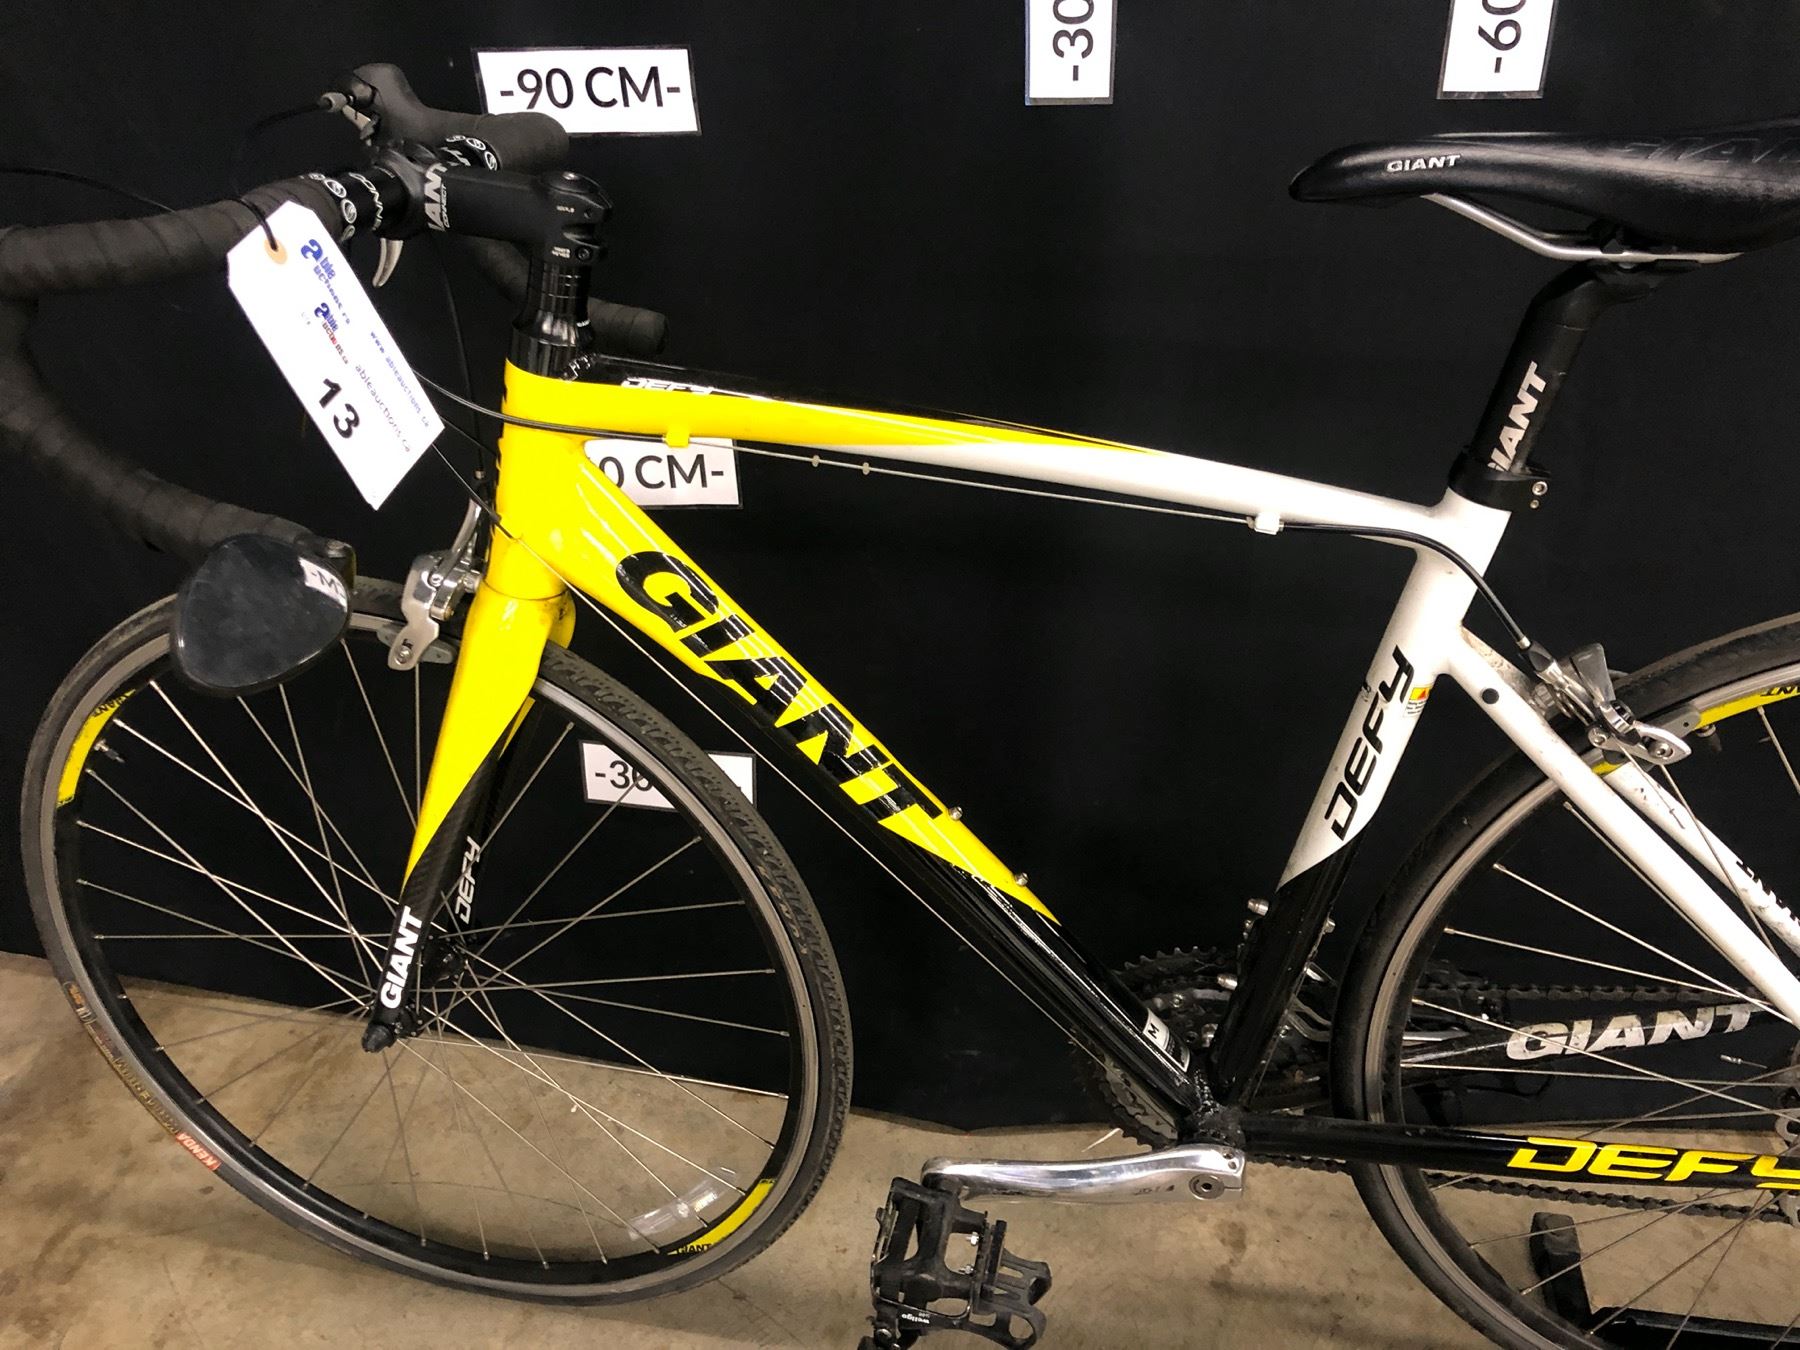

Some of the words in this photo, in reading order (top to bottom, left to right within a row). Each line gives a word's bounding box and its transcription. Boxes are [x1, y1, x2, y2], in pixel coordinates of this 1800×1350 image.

[500, 67, 574, 110] -90
[585, 66, 681, 109] CM-
[1386, 155, 1461, 173] GIANT
[318, 377, 361, 439] 13
[635, 453, 725, 490] CM-
[615, 550, 943, 823] GIANT
[1324, 644, 1415, 841] DEFY
[455, 836, 481, 925] DEFY
[381, 905, 423, 1010] GIANT
[1147, 1022, 1160, 1040] M
[1506, 1002, 1766, 1060] GIANT
[176, 1132, 219, 1168] KENDA
